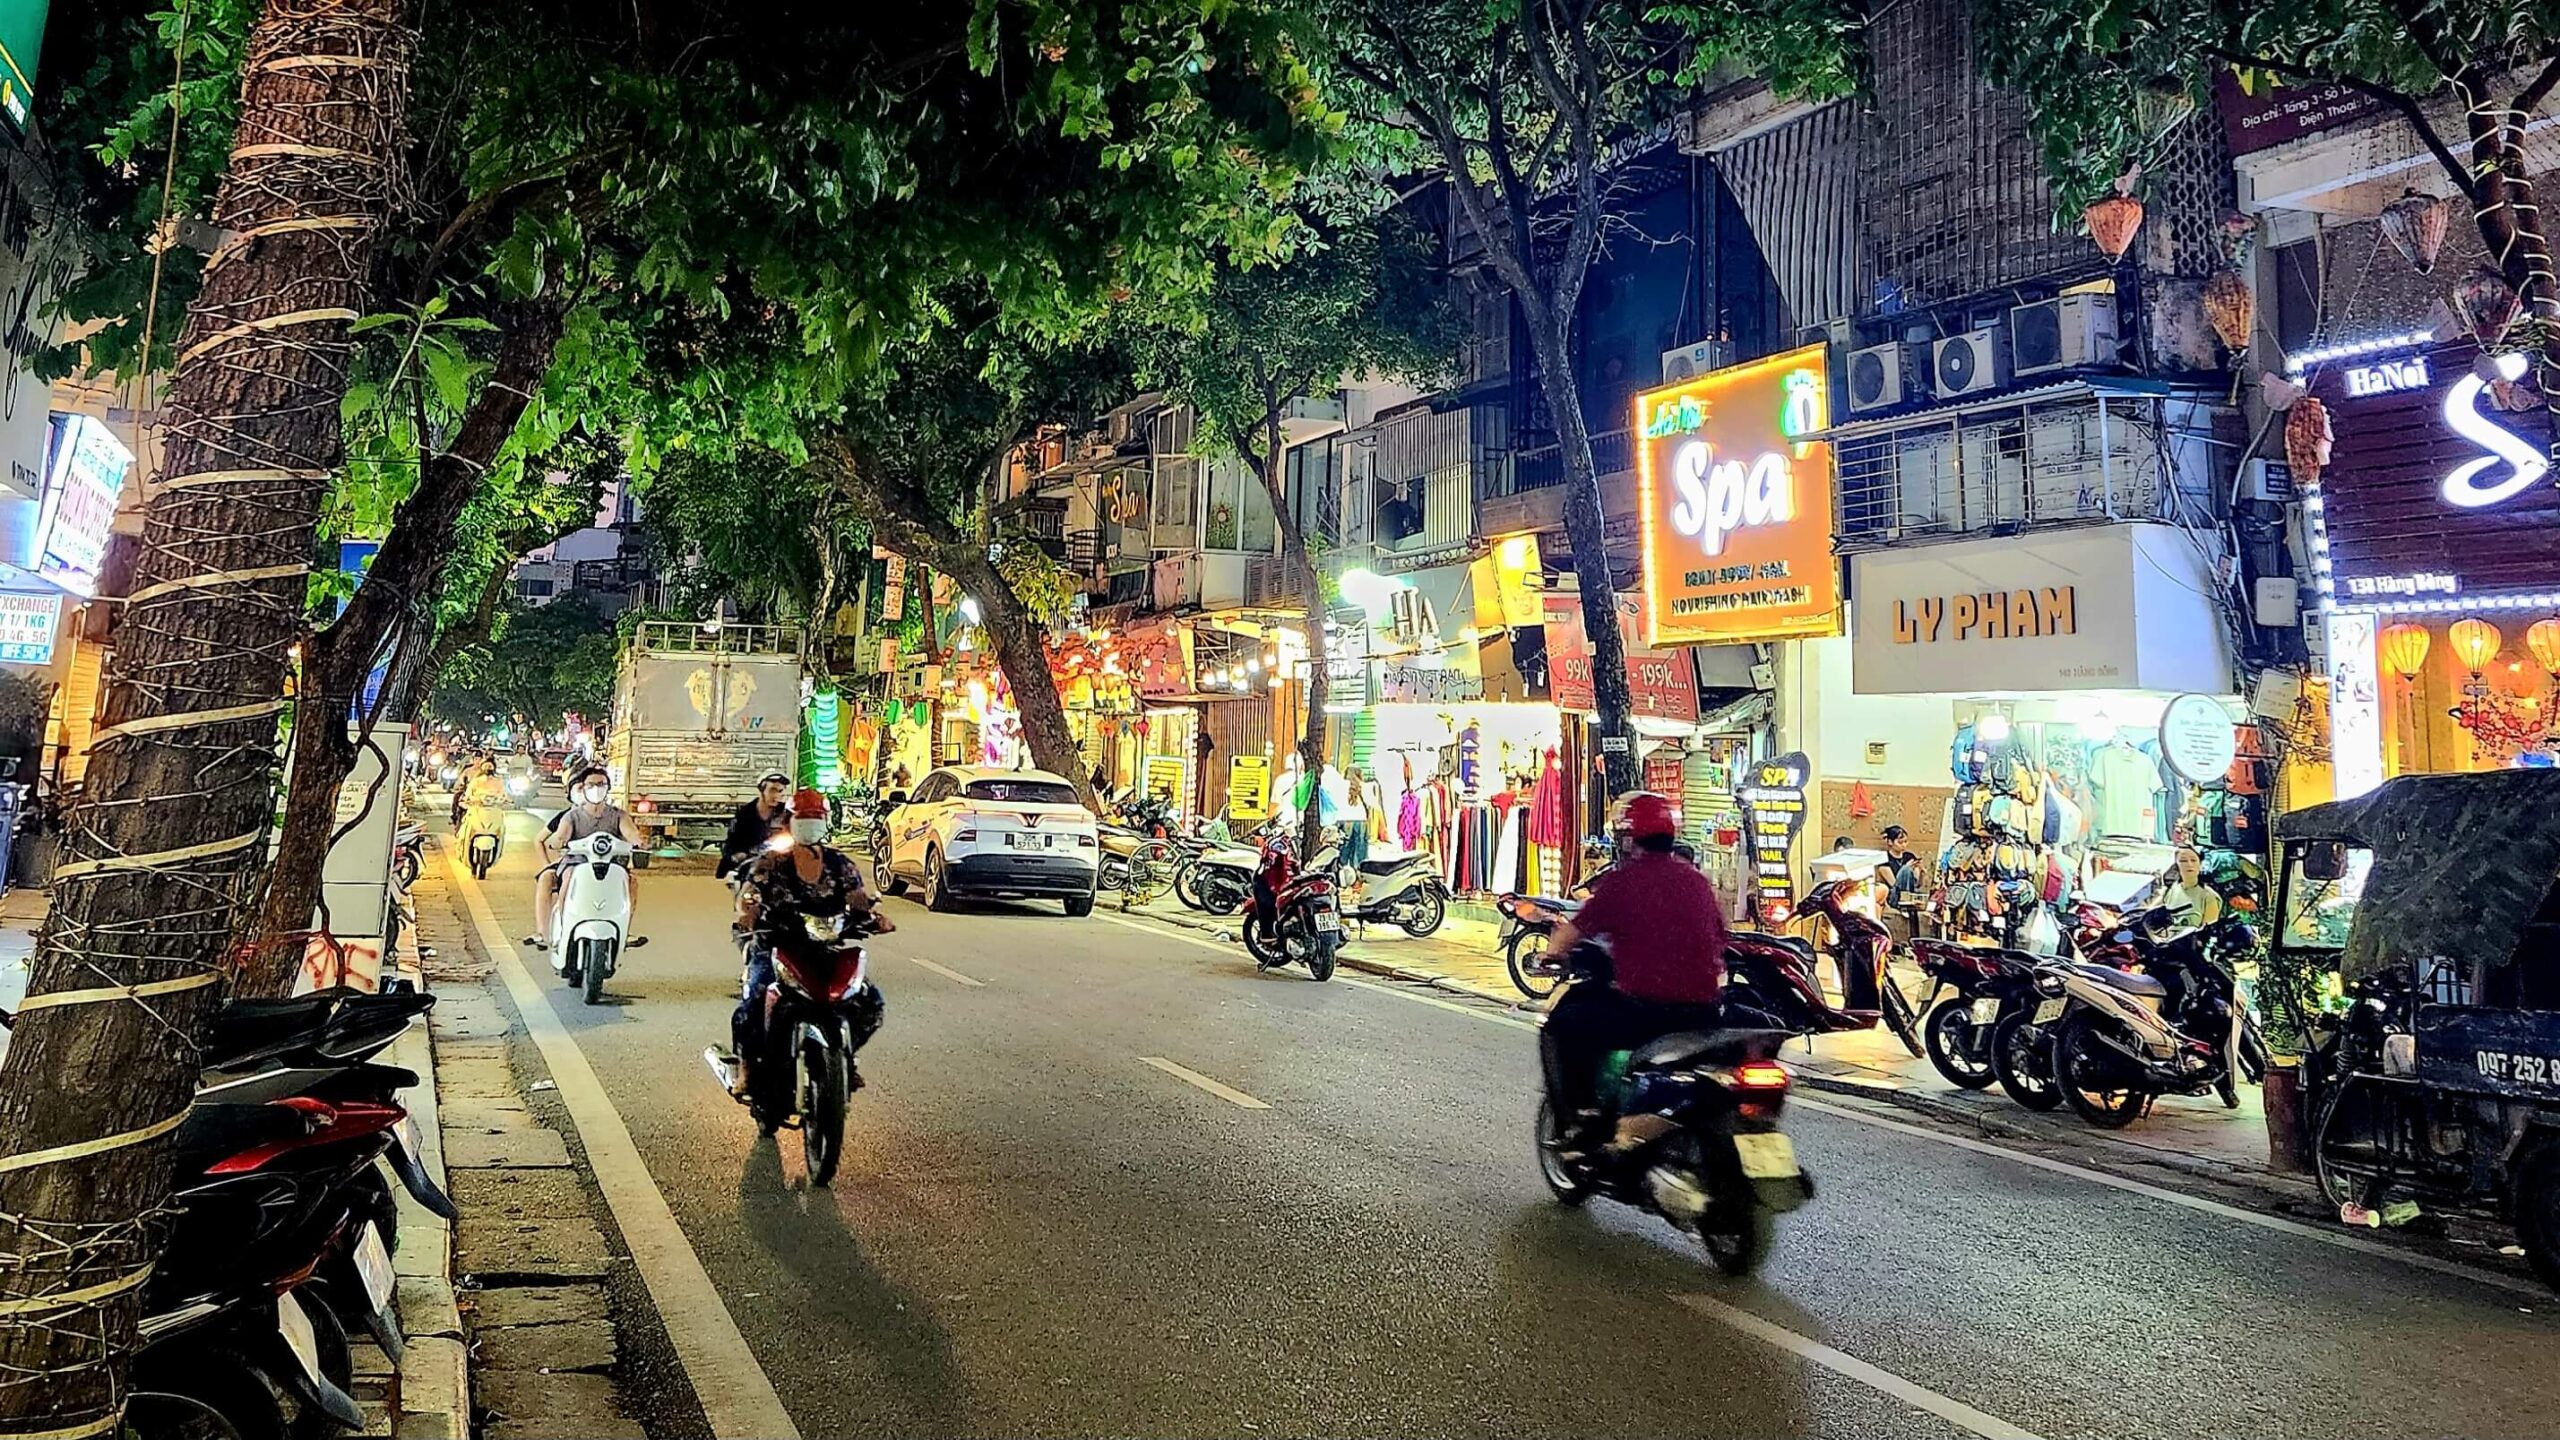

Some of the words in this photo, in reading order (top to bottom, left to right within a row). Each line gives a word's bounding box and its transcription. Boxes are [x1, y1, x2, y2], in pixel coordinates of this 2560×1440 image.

[1672, 440, 1796, 556] Spa
[0, 596, 55, 613] XCHANGE
[1893, 597, 1943, 644] LY
[1953, 586, 2076, 640] PHAM
[1565, 659, 1590, 681] 99k
[1761, 767, 1800, 787] SPA
[2513, 1055, 2547, 1084] 252
